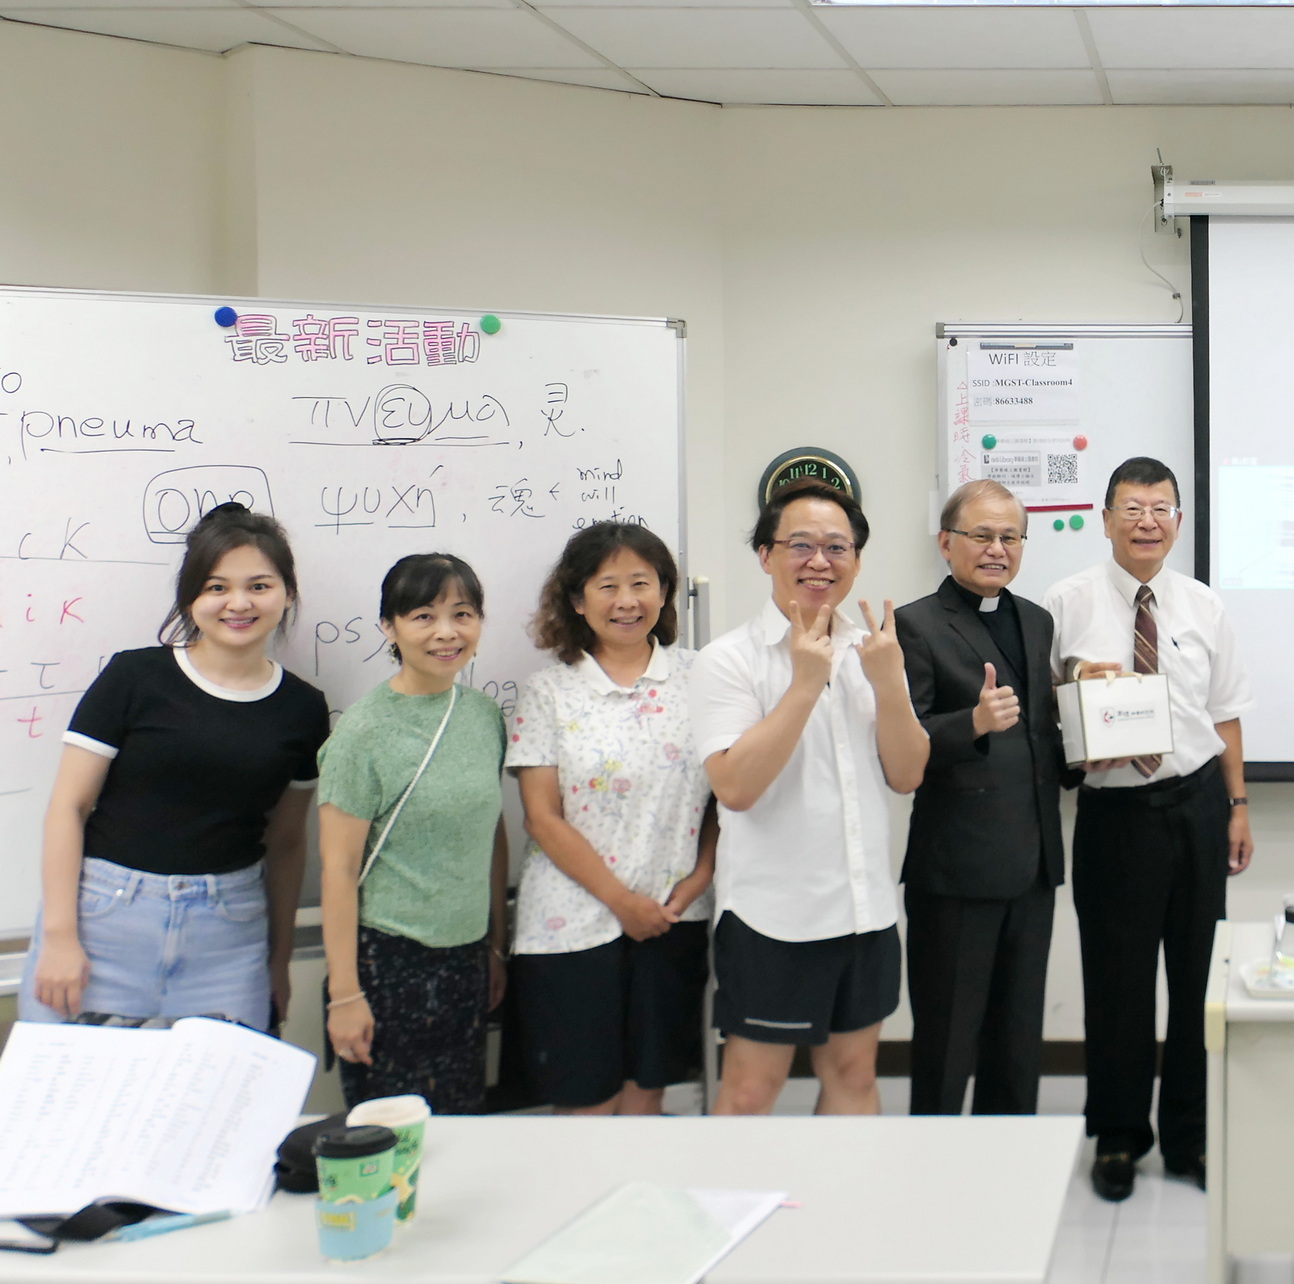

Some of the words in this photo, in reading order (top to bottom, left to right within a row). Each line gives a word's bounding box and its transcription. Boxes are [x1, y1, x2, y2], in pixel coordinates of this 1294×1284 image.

[224, 314, 481, 366] 最新活動
[1023, 351, 1057, 367] 設定
[972, 379, 991, 388] SSID
[20, 410, 204, 461] pneuma
[804, 463, 818, 476] 12
[830, 477, 841, 490] 2
[581, 485, 616, 505] will
